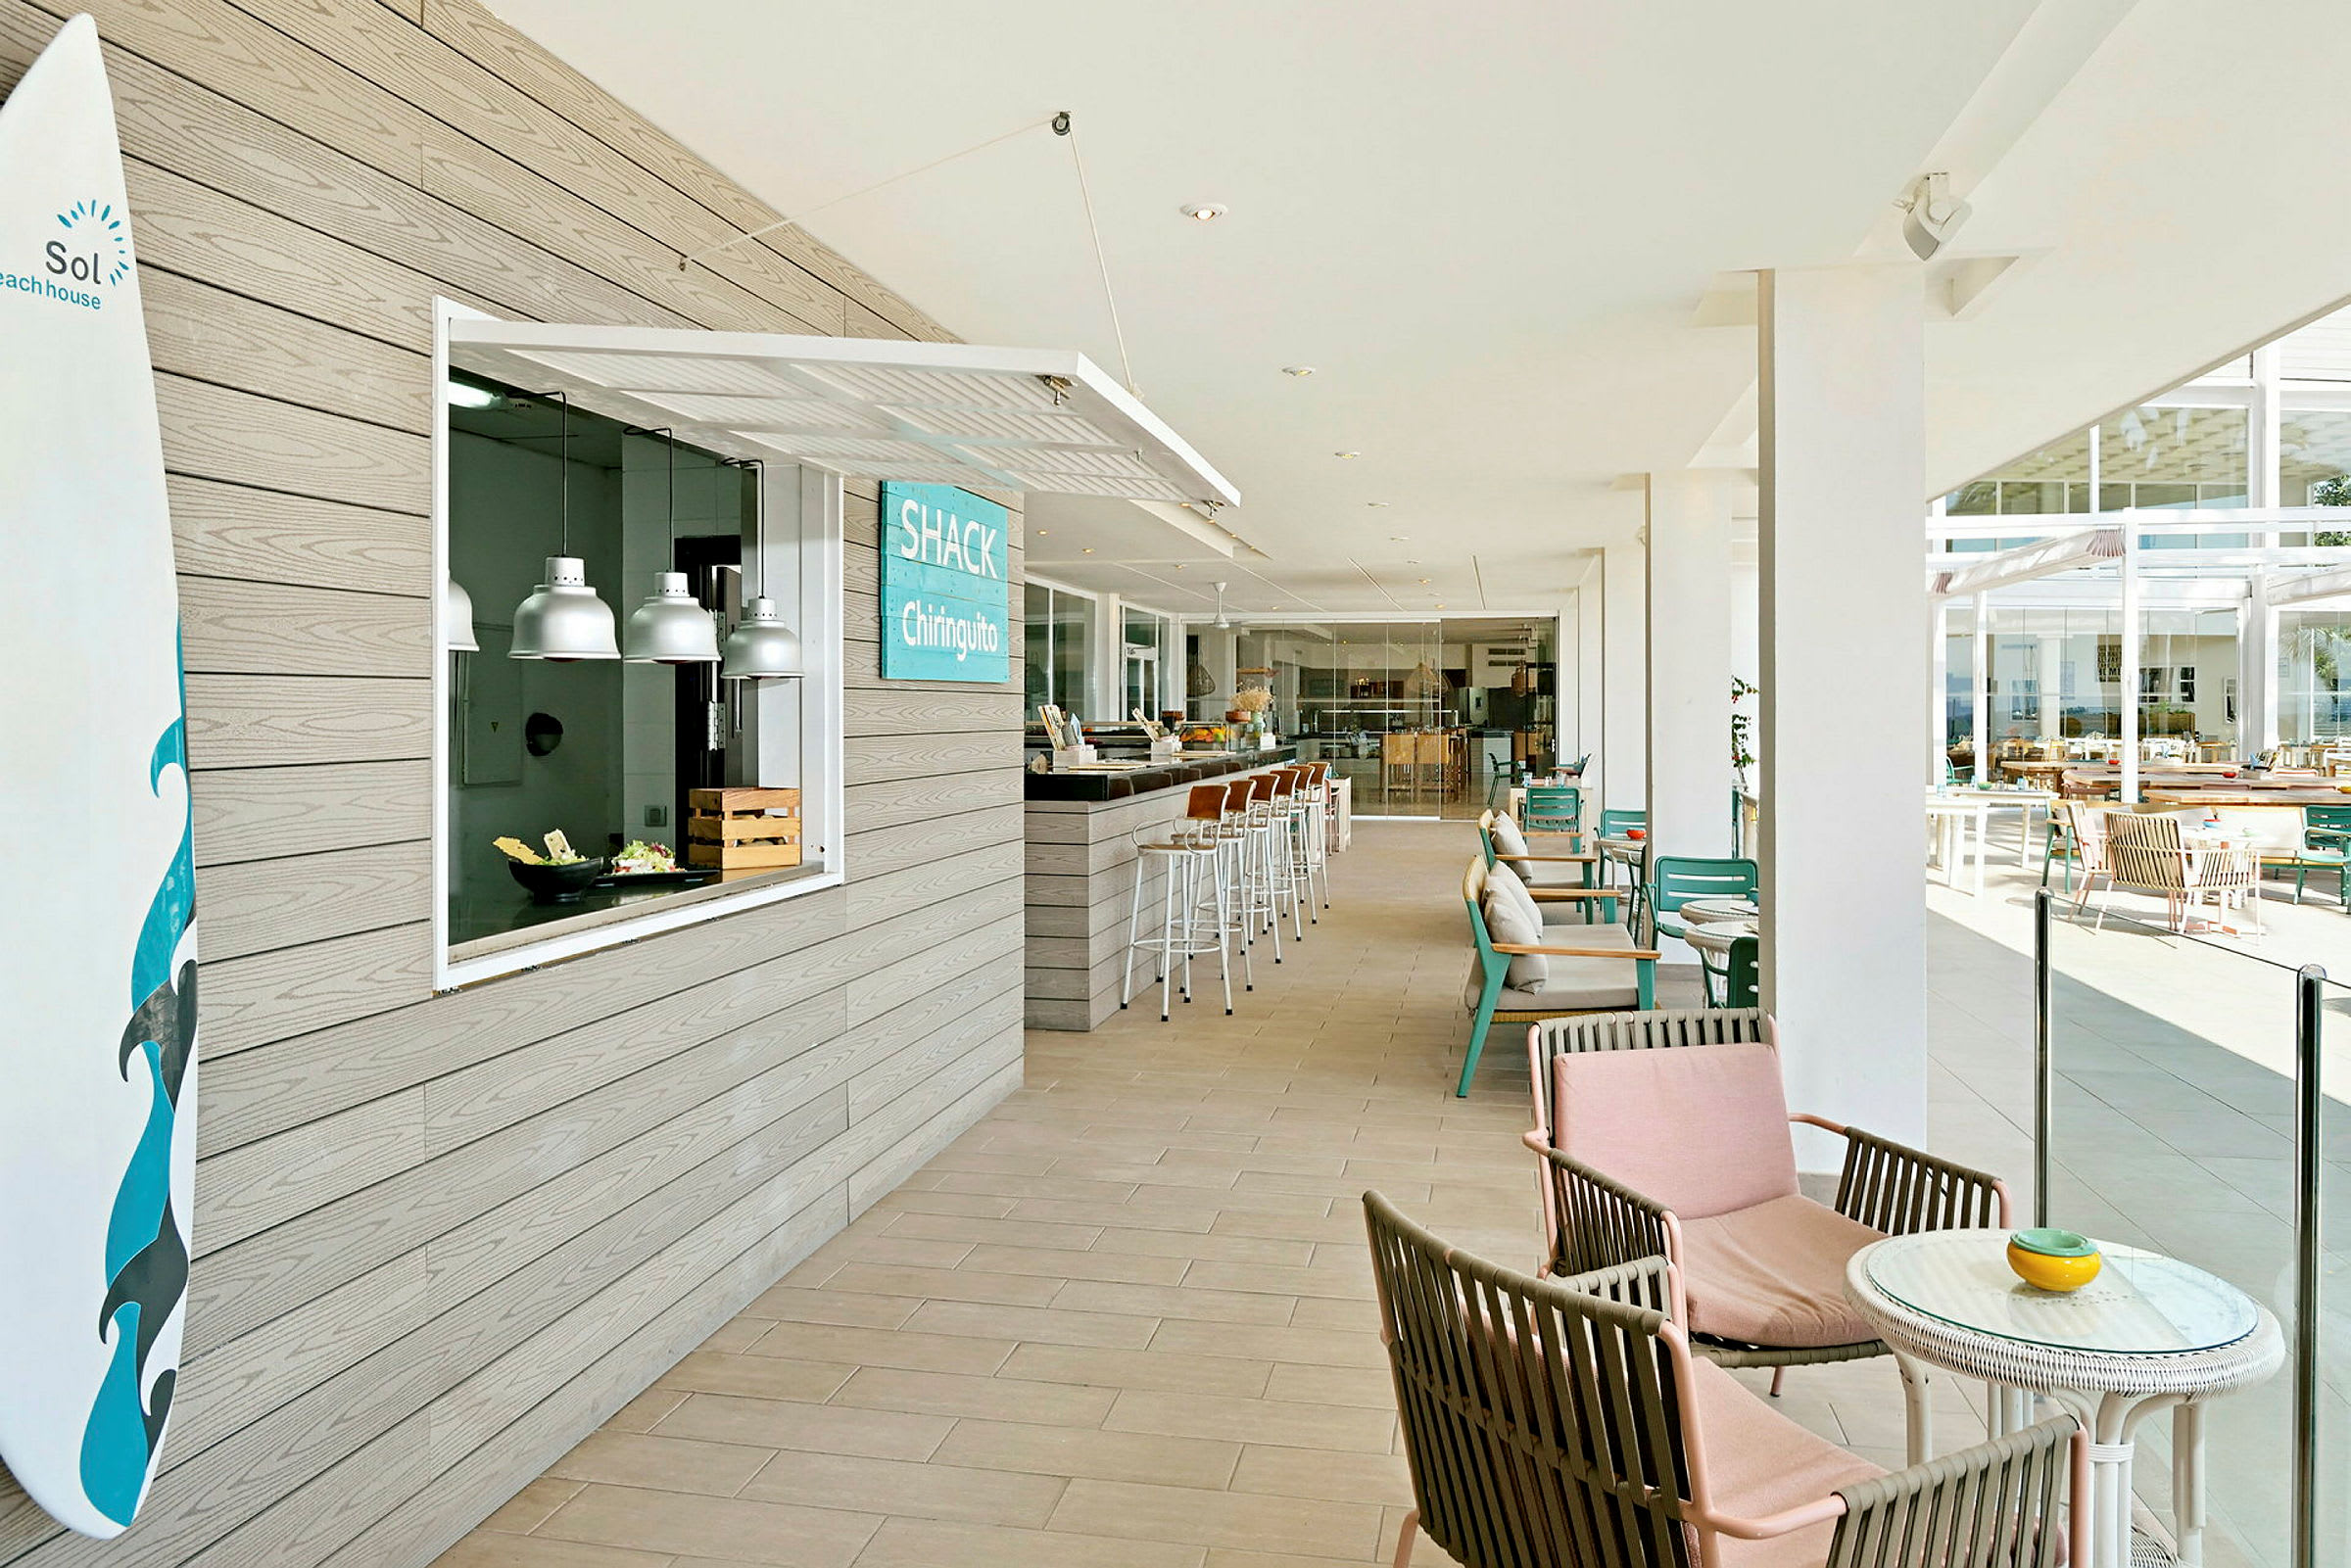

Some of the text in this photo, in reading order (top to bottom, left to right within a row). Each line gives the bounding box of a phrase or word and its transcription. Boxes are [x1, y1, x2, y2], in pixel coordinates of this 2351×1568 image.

[46, 240, 101, 285] Sol
[900, 499, 998, 579] SHACK
[902, 600, 999, 662] Chiringuito
